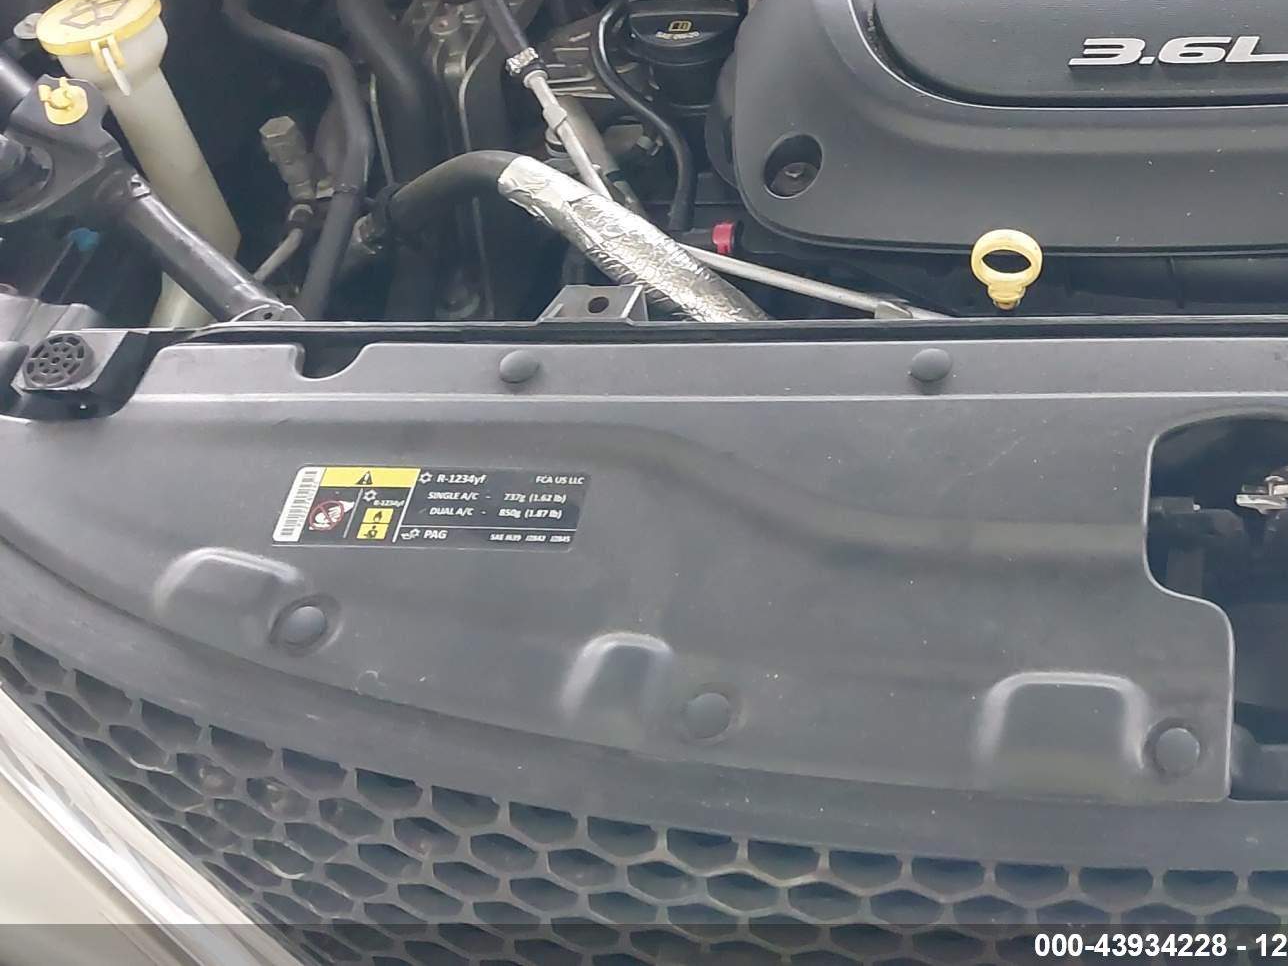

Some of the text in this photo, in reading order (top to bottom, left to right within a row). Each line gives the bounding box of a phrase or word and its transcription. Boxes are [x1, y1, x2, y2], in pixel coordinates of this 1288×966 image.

[436, 473, 487, 485] R-1234yf
[535, 475, 585, 485] FCA US LLC
[427, 491, 460, 501] SINGLE
[461, 491, 480, 501] A/C
[429, 507, 454, 516] DUAL
[455, 507, 475, 516] A/C
[423, 529, 449, 540] PAG
